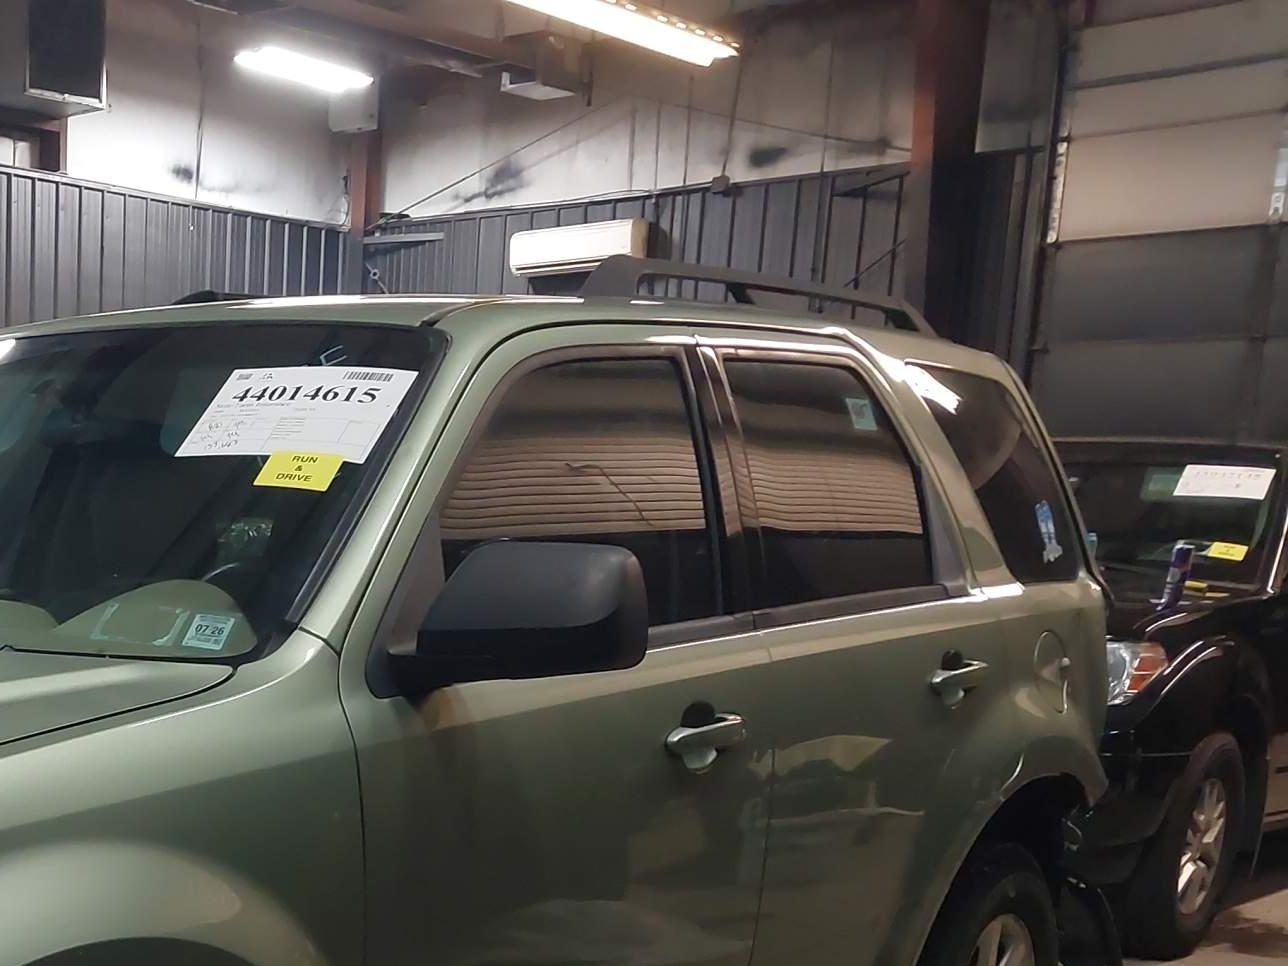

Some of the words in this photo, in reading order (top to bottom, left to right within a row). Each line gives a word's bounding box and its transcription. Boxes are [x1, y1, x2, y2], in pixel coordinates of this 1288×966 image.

[232, 385, 382, 404] 44014615
[291, 455, 319, 464] RUN
[275, 472, 313, 482] DRIVE
